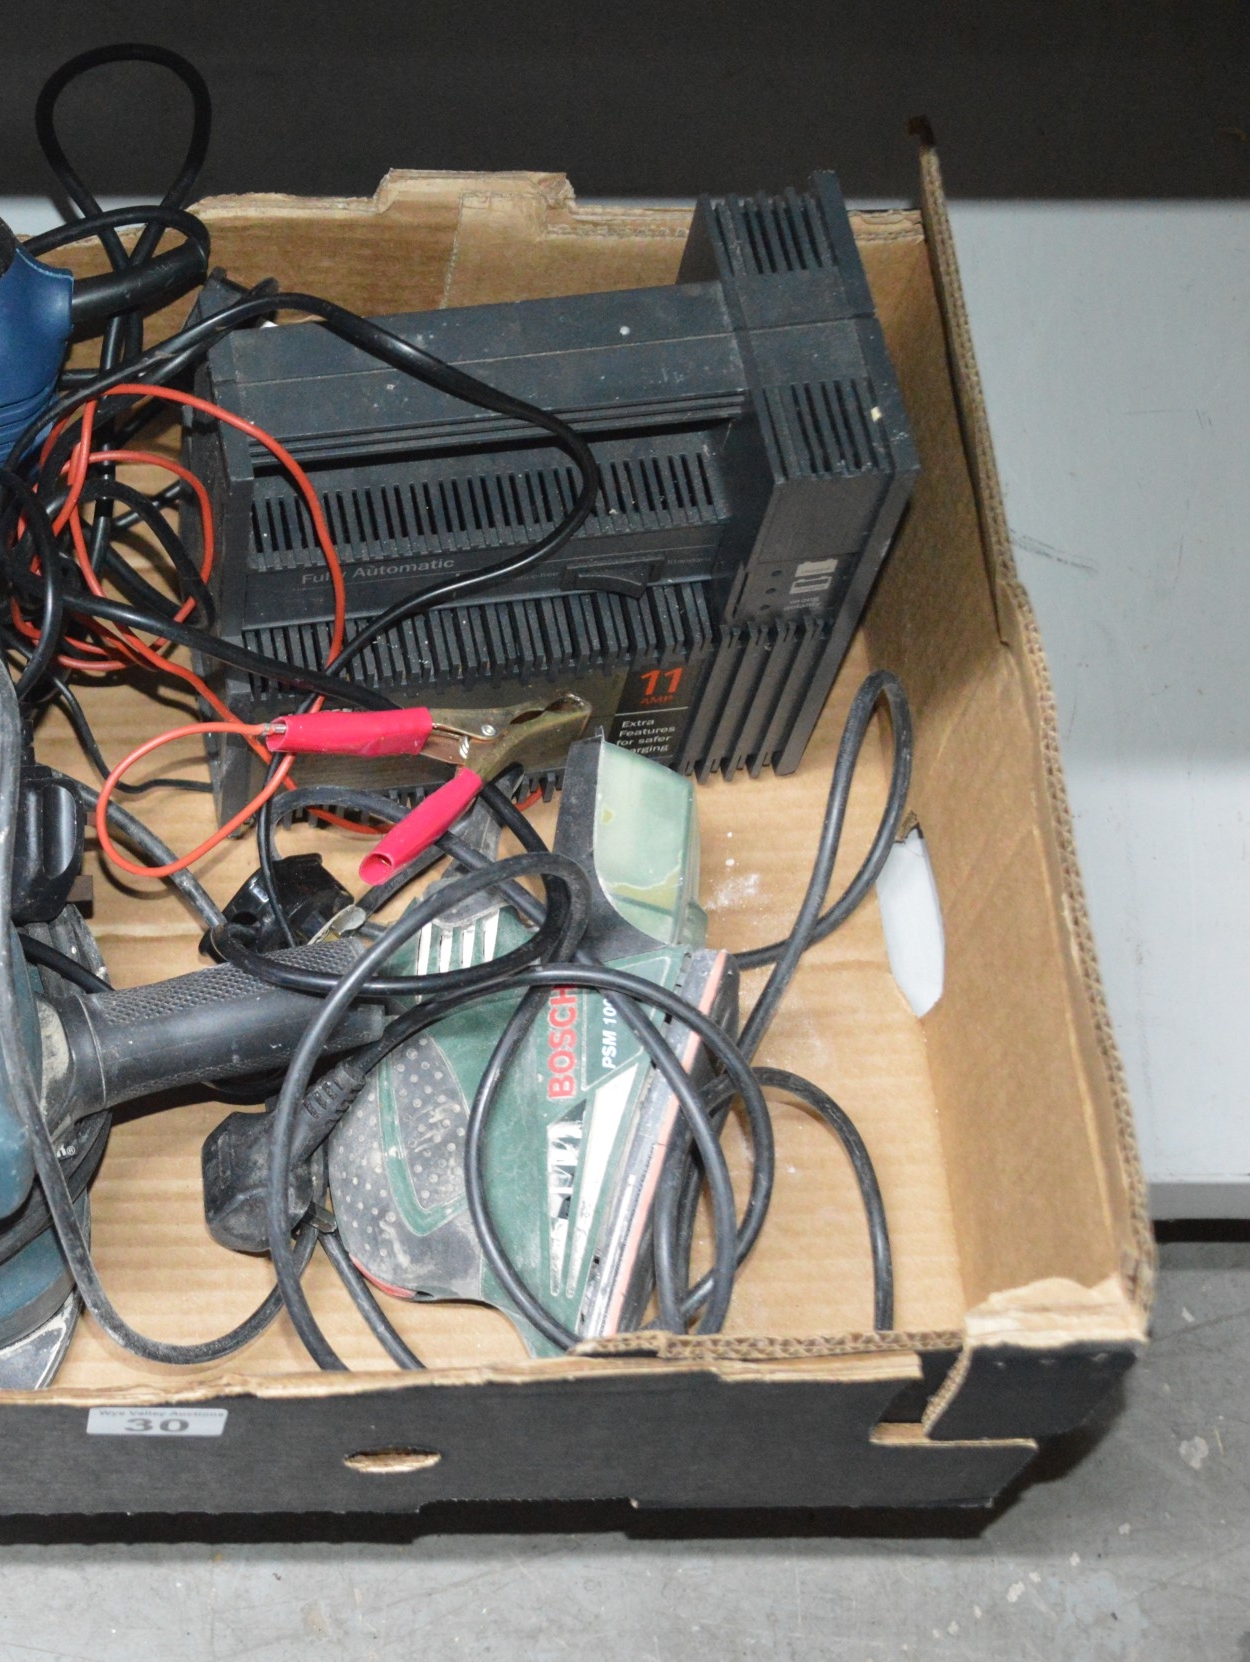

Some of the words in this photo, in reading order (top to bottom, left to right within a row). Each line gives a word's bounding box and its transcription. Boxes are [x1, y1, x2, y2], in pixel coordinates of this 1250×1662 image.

[301, 570, 347, 584] Ful
[352, 558, 455, 579] Automatic
[640, 666, 683, 696] 11
[639, 694, 674, 705] AMP
[621, 719, 655, 728] Extra
[618, 726, 676, 737] Features
[638, 735, 672, 745] safer
[547, 984, 578, 1100] BOSCH
[601, 1029, 617, 1070] PSM
[129, 1409, 166, 1417] Valley
[124, 1417, 190, 1433] 30
